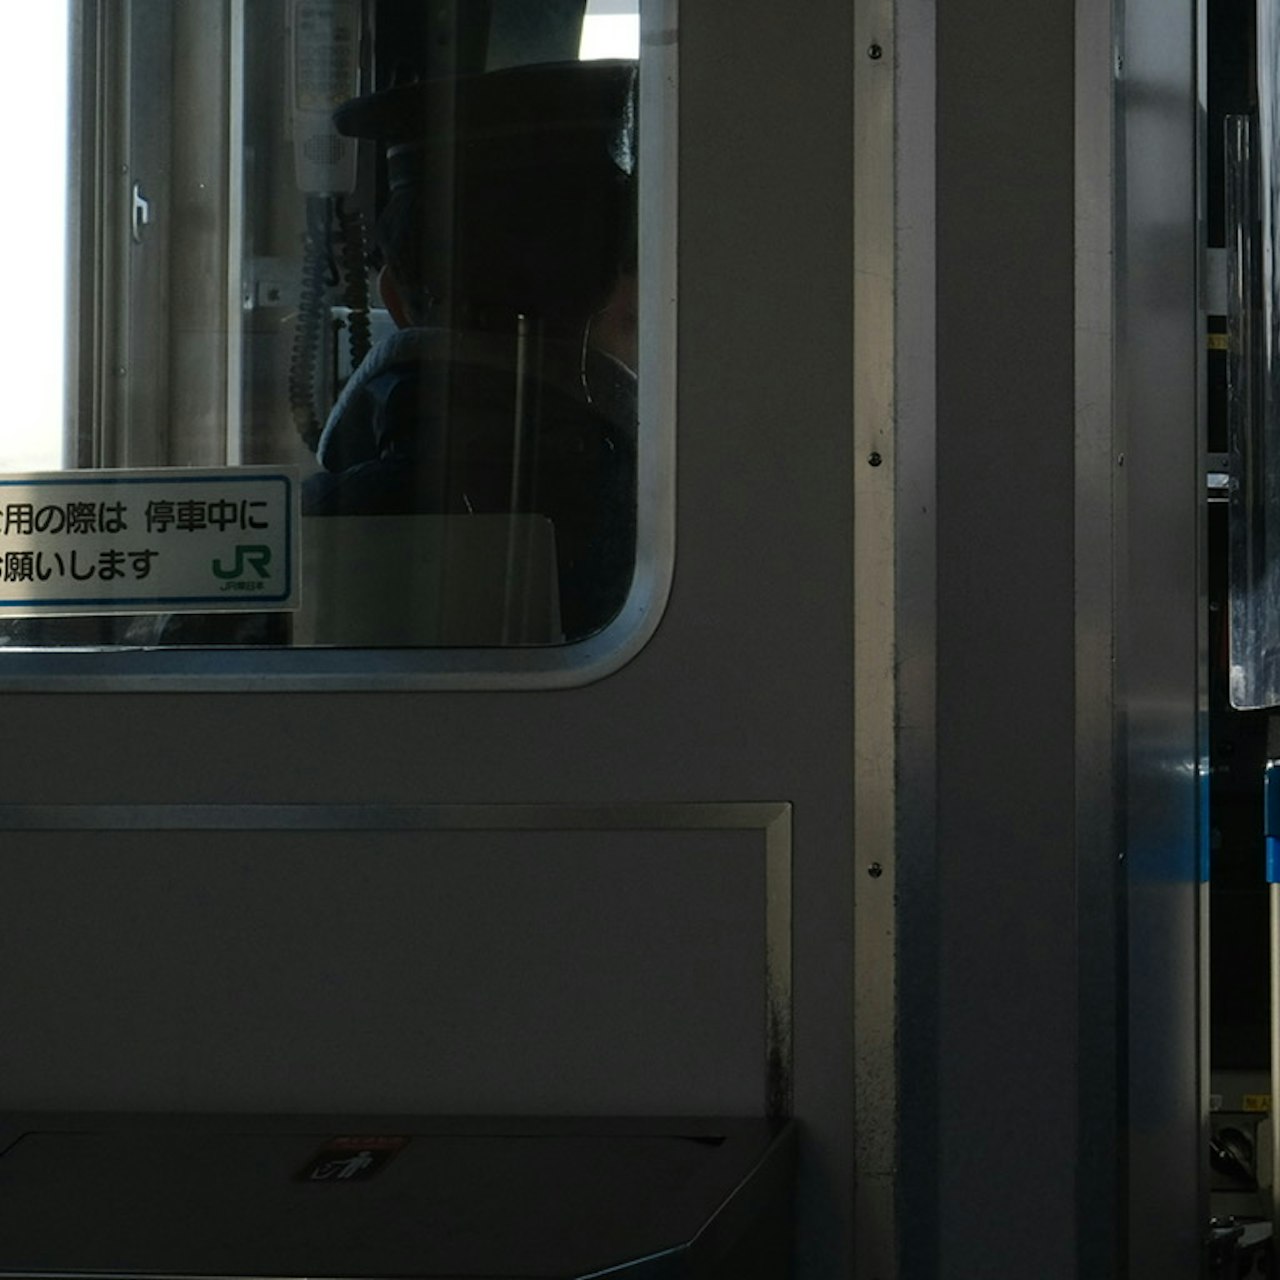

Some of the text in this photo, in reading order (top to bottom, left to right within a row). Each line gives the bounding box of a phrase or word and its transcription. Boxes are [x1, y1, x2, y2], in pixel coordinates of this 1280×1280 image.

[0, 499, 268, 534] 用の際は 停車中に
[0, 549, 159, 582] 願いします
[212, 545, 271, 579] JR
